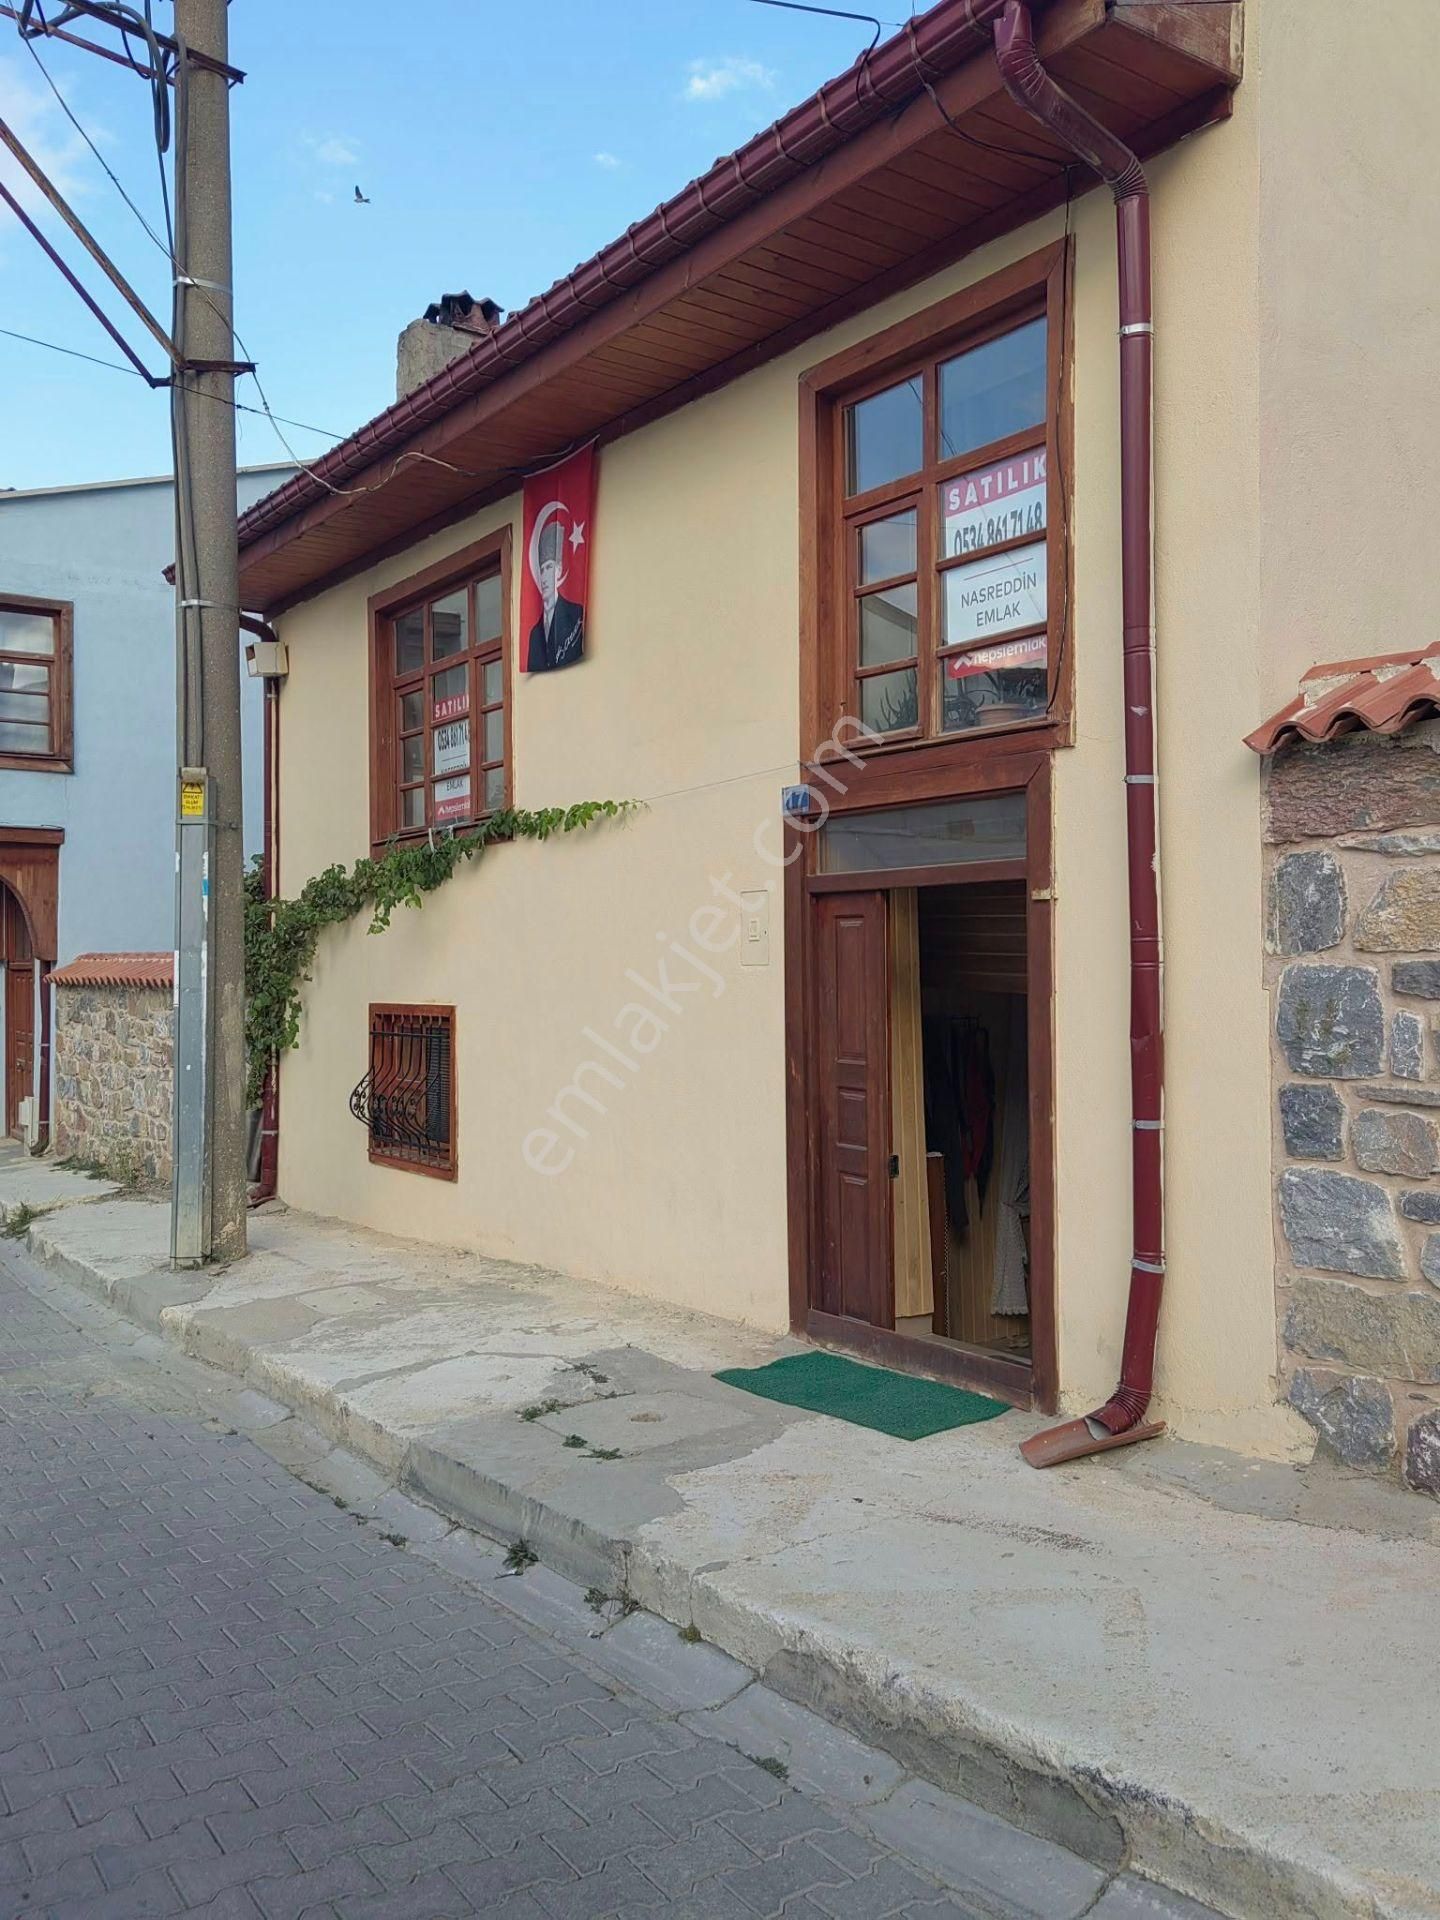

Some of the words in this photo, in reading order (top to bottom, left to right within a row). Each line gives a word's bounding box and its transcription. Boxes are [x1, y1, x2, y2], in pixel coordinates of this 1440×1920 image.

[949, 453, 1046, 511] SATILIK
[954, 522, 984, 555] 0534
[961, 571, 1037, 608] NASREDDİN
[976, 600, 1021, 627] EMLAK
